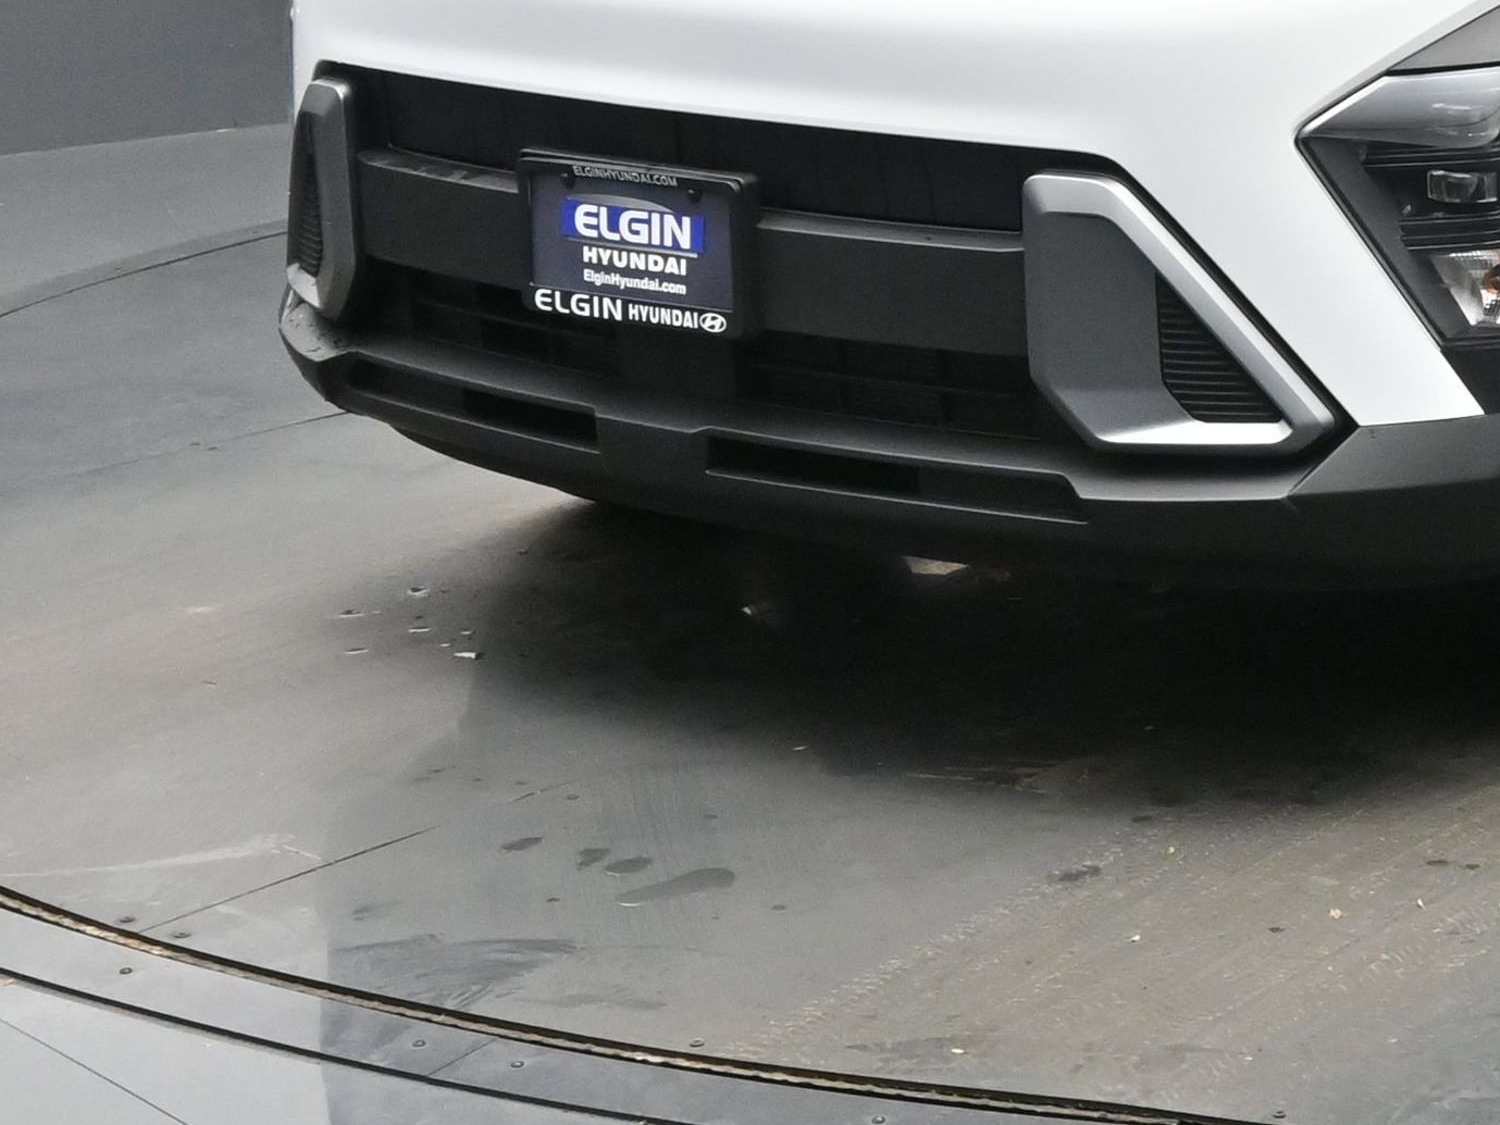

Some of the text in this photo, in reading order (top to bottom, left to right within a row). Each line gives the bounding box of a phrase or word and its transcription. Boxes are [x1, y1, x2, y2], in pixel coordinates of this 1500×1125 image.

[574, 203, 691, 249] ELGIN
[582, 245, 687, 276] HYUNDAI
[583, 269, 687, 295] ElginHyundai.com
[534, 288, 699, 329] ELGIN HYUNDAI
